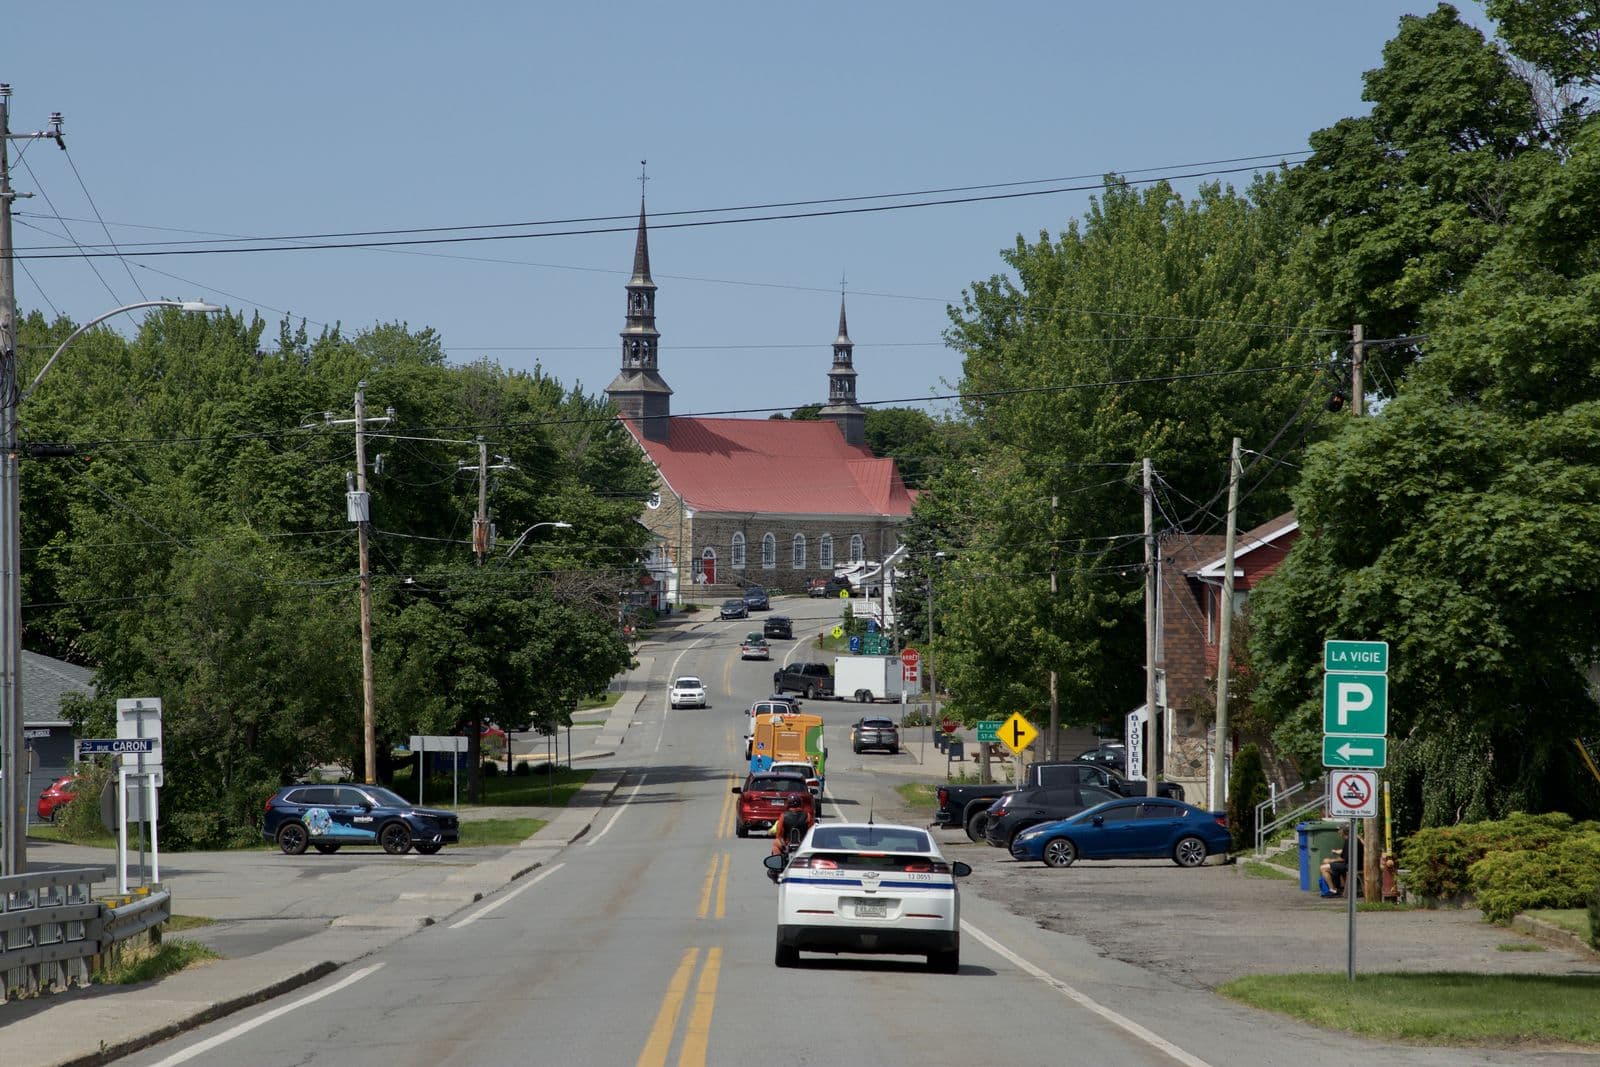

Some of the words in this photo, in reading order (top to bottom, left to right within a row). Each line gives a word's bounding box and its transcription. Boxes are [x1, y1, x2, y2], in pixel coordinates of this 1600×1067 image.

[1331, 651, 1347, 662] LA
[1350, 651, 1381, 663] VIGIE
[1338, 682, 1373, 726] P
[112, 741, 147, 751] CARON
[1131, 714, 1139, 776] BIJOUTERIE
